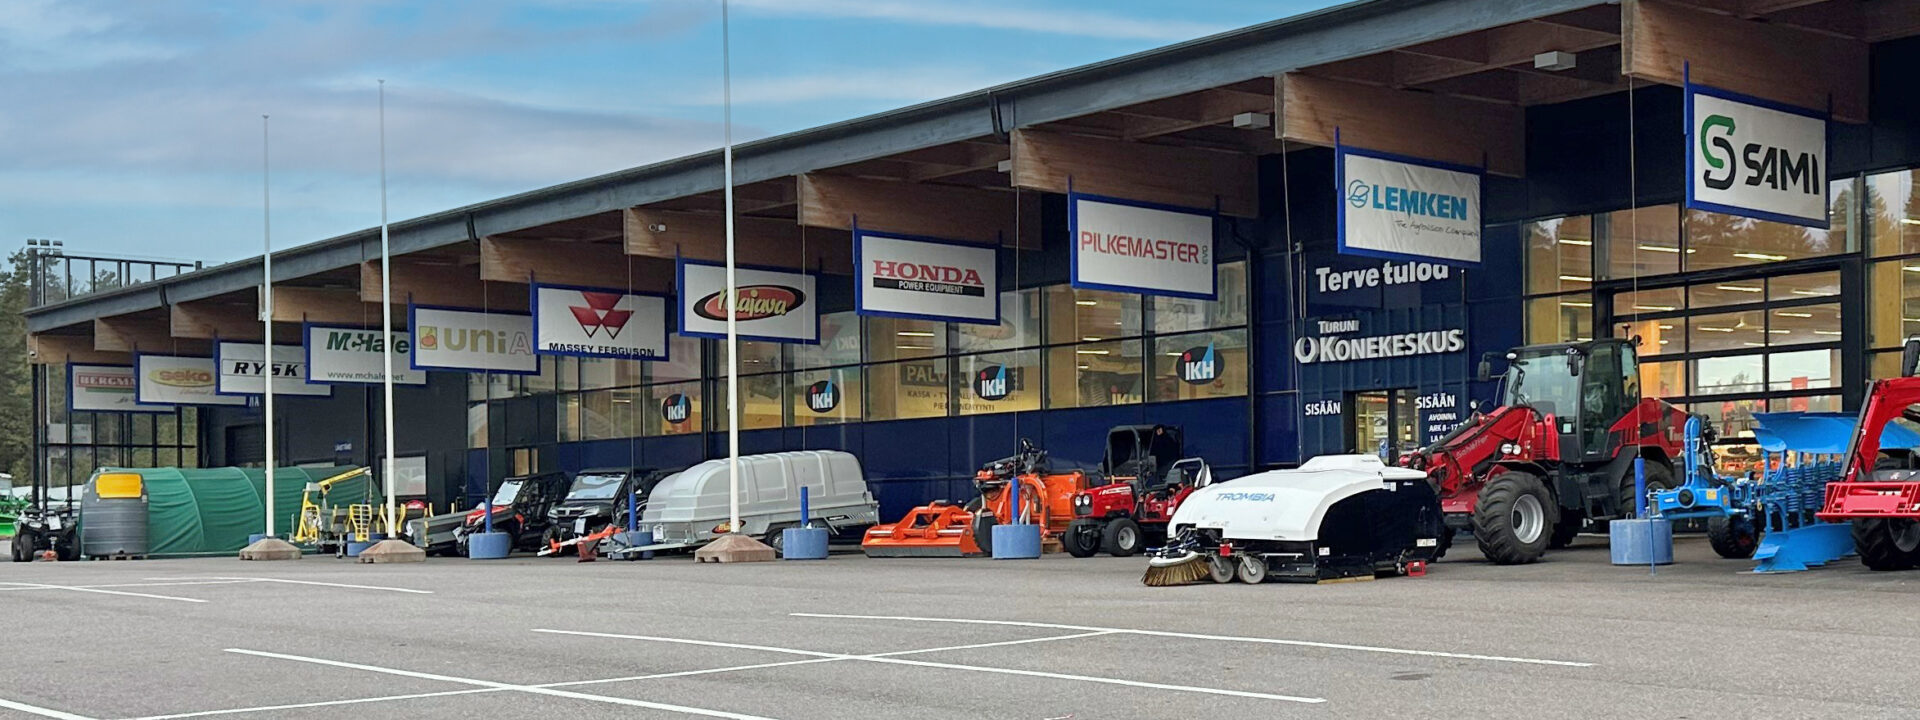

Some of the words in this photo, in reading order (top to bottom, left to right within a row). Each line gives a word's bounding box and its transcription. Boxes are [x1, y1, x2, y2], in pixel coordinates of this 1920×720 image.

[1743, 143, 1820, 195] SAMI
[1373, 184, 1467, 221] LEMKEN
[1081, 231, 1199, 264] PILKEMASTER
[873, 260, 984, 285] HONDA
[898, 280, 924, 290] POWER
[925, 282, 964, 294] EQUIPMENT
[549, 342, 594, 354] MASSEY
[598, 345, 655, 357] FERGUSON
[1320, 329, 1464, 362] KONEKESKUS
[233, 362, 299, 376] RYSK
[327, 371, 405, 381] www.mchalenet
[80, 376, 136, 385] BERGMA
[1305, 400, 1341, 416] SISÄÄN
[1416, 392, 1455, 409] SISÄÄN
[1216, 492, 1275, 502] TROMBIA
